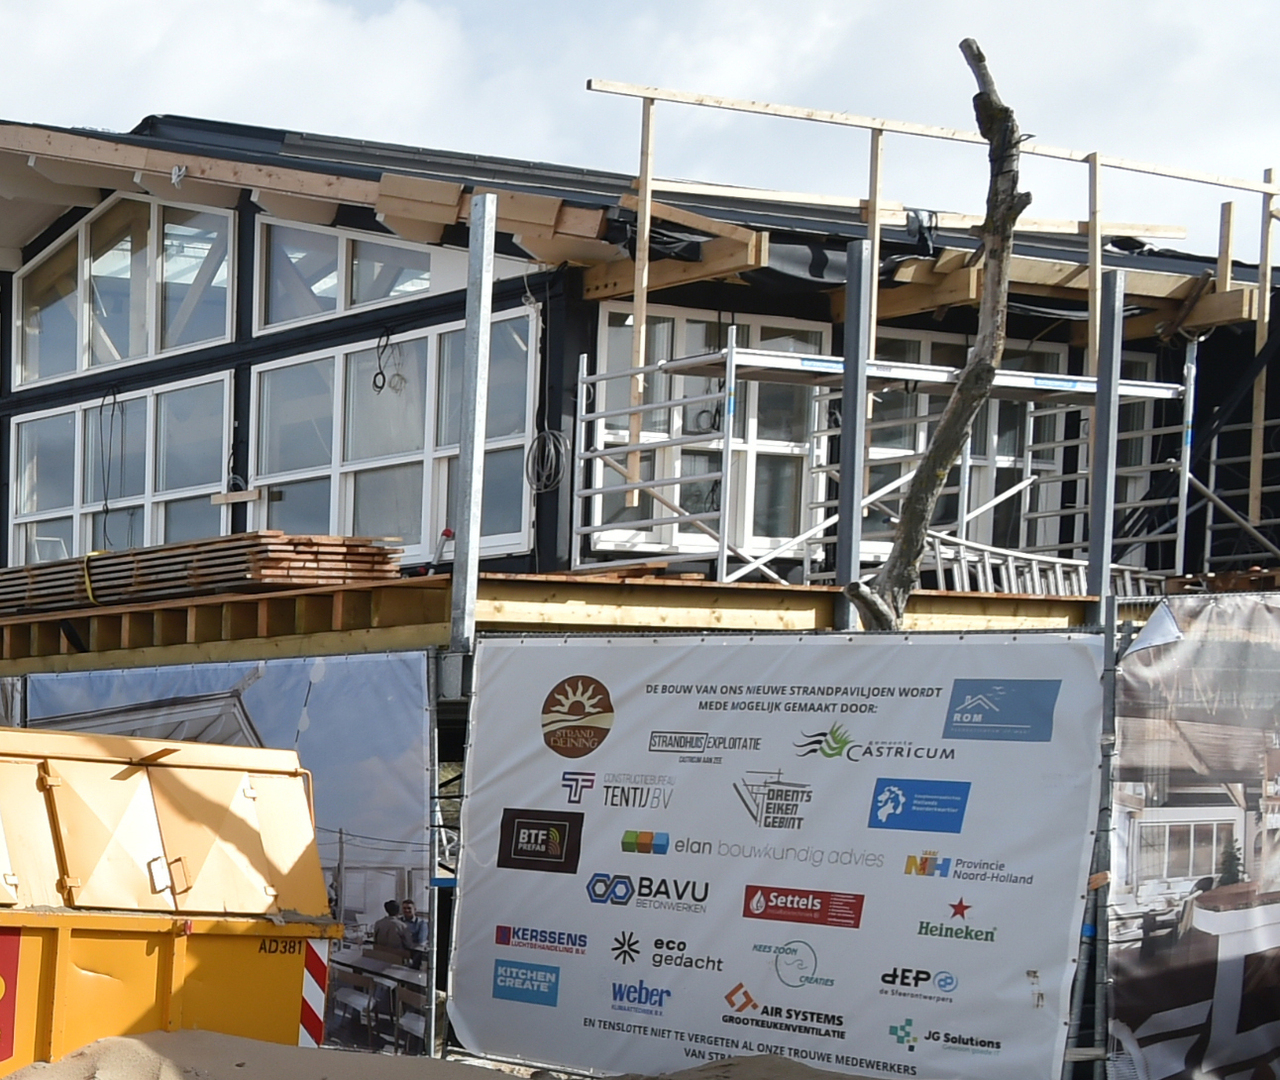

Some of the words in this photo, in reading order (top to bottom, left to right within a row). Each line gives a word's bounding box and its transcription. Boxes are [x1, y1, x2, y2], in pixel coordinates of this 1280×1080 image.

[646, 685, 659, 694] DE
[661, 685, 692, 694] BOUW
[696, 685, 717, 694] VAN
[720, 686, 743, 695] ONS
[746, 686, 787, 695] NIEUWE
[789, 686, 895, 699] STRANDPAVILJOEN
[899, 688, 942, 697] WORDT
[698, 701, 728, 710] MEDE
[731, 702, 781, 713] MOGELIJK
[784, 703, 837, 712] GEMAAKT
[840, 704, 878, 713] DOOR:
[953, 713, 982, 722] ROM
[556, 729, 594, 738] STRAND
[550, 738, 598, 748] DEINING
[652, 735, 705, 748] STRANDHUIS
[707, 736, 761, 750] EXPLOITATIE
[847, 744, 955, 762] CASTRICUM
[604, 786, 649, 808] TENTIJ
[650, 788, 673, 809] BV
[767, 789, 813, 802] DRENTS
[765, 803, 798, 815] EIKEN
[764, 816, 804, 829] GEBINT
[519, 829, 547, 844] BTF
[518, 843, 546, 852] PREFAB
[675, 838, 712, 854] elan
[717, 840, 824, 867] bouwkundig
[828, 850, 884, 867] advies
[955, 859, 1005, 871] Provincie
[953, 870, 1033, 884] Noord-Holland
[638, 877, 709, 902] BAVU
[636, 899, 706, 913] BETONWERKEN
[768, 892, 821, 910] Settels
[512, 927, 587, 947] KERSSENS
[918, 921, 996, 942] Heineken
[258, 939, 302, 955] AD381
[654, 939, 686, 951] eco
[652, 953, 723, 971] gedacht
[498, 966, 556, 982] KITCHEN
[800, 976, 834, 986] CREATIES
[497, 978, 549, 992] CREATE
[612, 980, 671, 1007] weber
[761, 1006, 782, 1018] AIR
[786, 1009, 843, 1026] SYSTEMS
[722, 1015, 846, 1039] GROOTKEUKENVENTILATIE
[583, 1018, 595, 1028] EN
[598, 1020, 648, 1035] TENSLOTTE
[650, 1027, 671, 1039] NIET
[674, 1031, 685, 1041] TE
[688, 1033, 739, 1049] VERGETEN
[742, 1041, 755, 1051] AL
[757, 1043, 785, 1056] ONZE
[788, 1048, 832, 1063] TROUWE
[835, 1055, 917, 1076] MEDEWERKERS
[924, 1031, 941, 1042] JG
[943, 1033, 1001, 1049] Solutions
[684, 1048, 705, 1060] VAN
